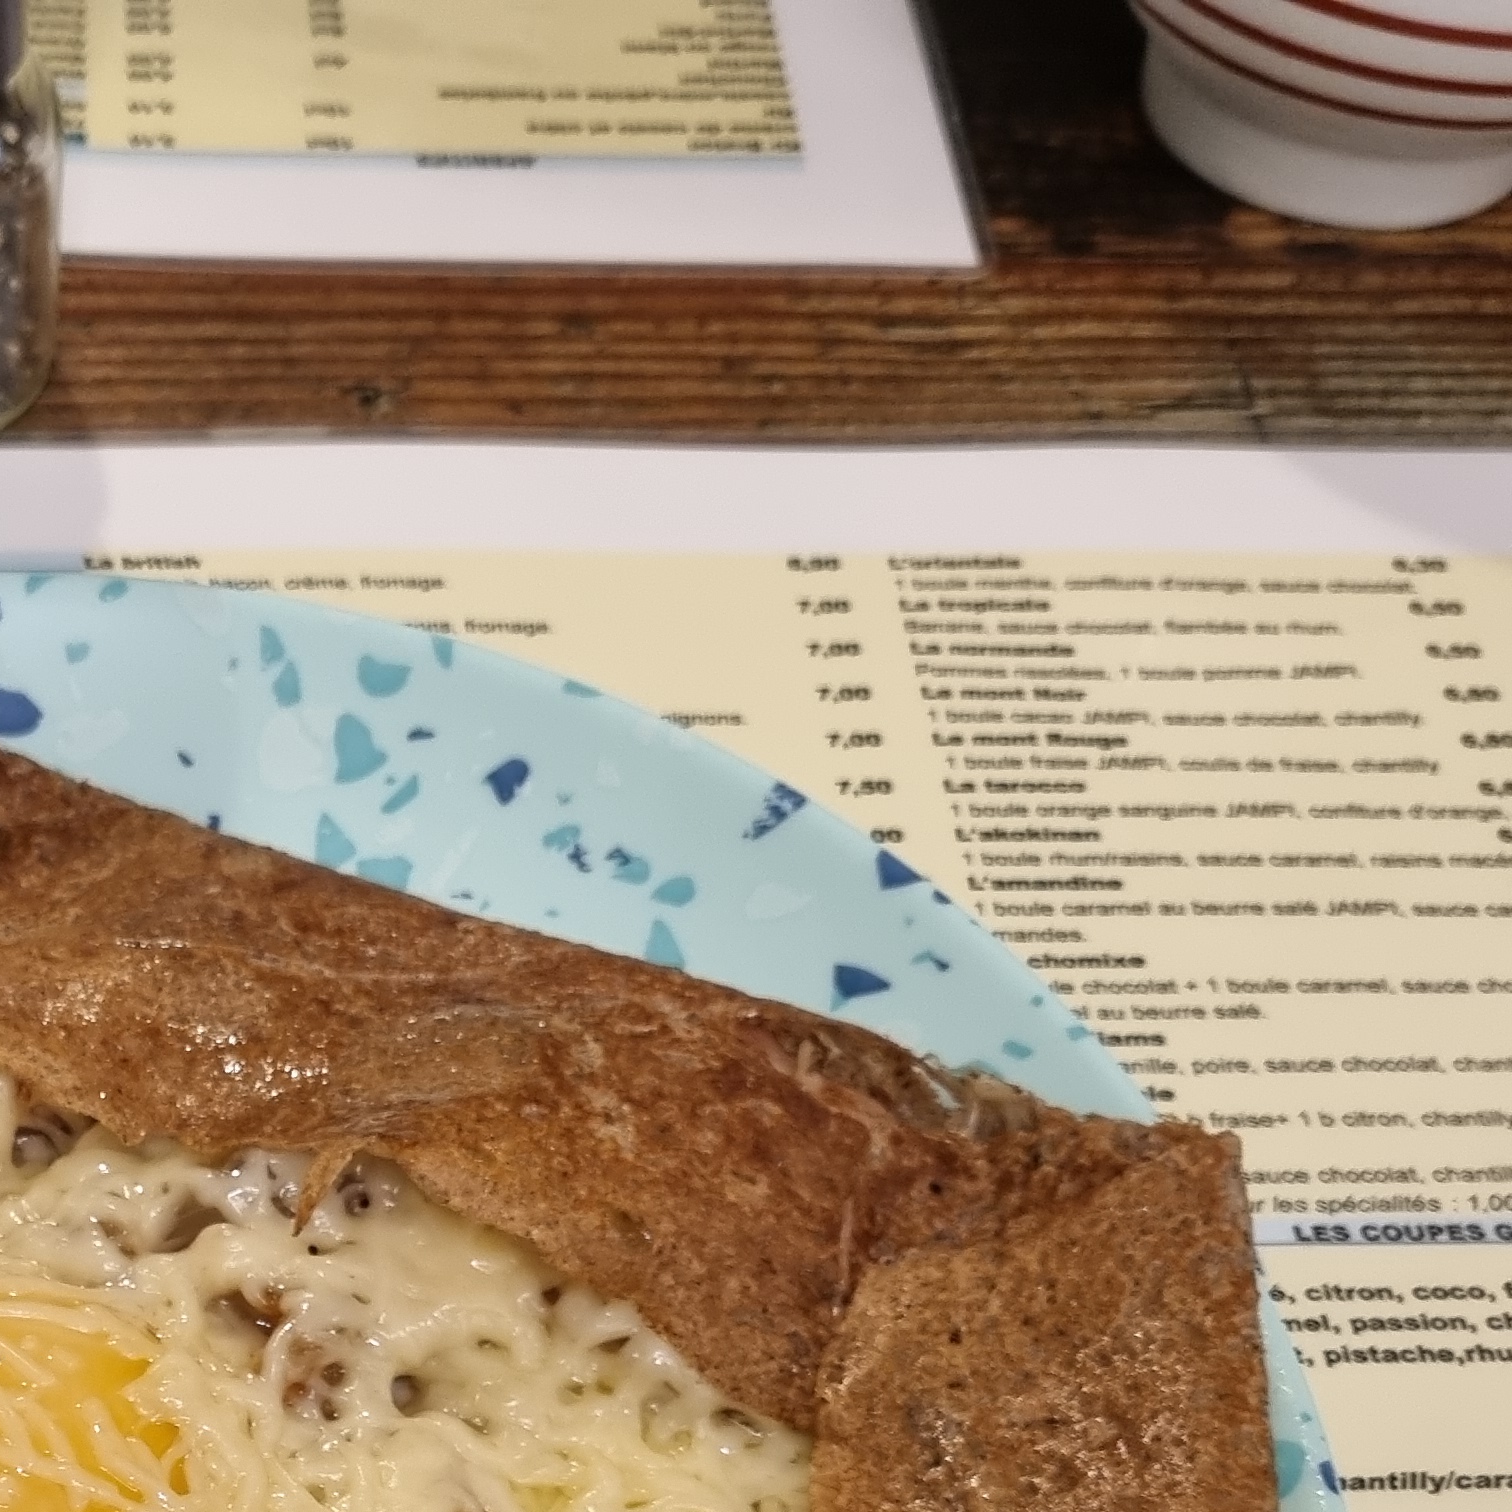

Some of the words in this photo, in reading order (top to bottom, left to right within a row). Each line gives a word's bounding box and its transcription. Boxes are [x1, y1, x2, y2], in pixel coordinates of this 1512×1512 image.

[943, 779, 976, 793] La
[980, 853, 1042, 867] boule
[967, 876, 1123, 891] L'amandine
[992, 902, 1055, 917] boule
[1062, 901, 1152, 916] caramel
[1158, 903, 1186, 916] au
[1082, 980, 1178, 995] chocolat
[1225, 978, 1291, 994] boule
[1401, 980, 1471, 994] sauce
[1097, 1008, 1126, 1020] au
[1131, 1005, 1207, 1020] beurre
[1263, 1060, 1335, 1073] sauce
[1273, 1196, 1309, 1213] les
[1315, 1195, 1442, 1216] spécialités
[1293, 1225, 1351, 1244] LES
[1360, 1224, 1486, 1244] COUPES
[1305, 1284, 1404, 1303] citron,
[1412, 1286, 1496, 1302] coco,
[1349, 1314, 1478, 1335] passion,
